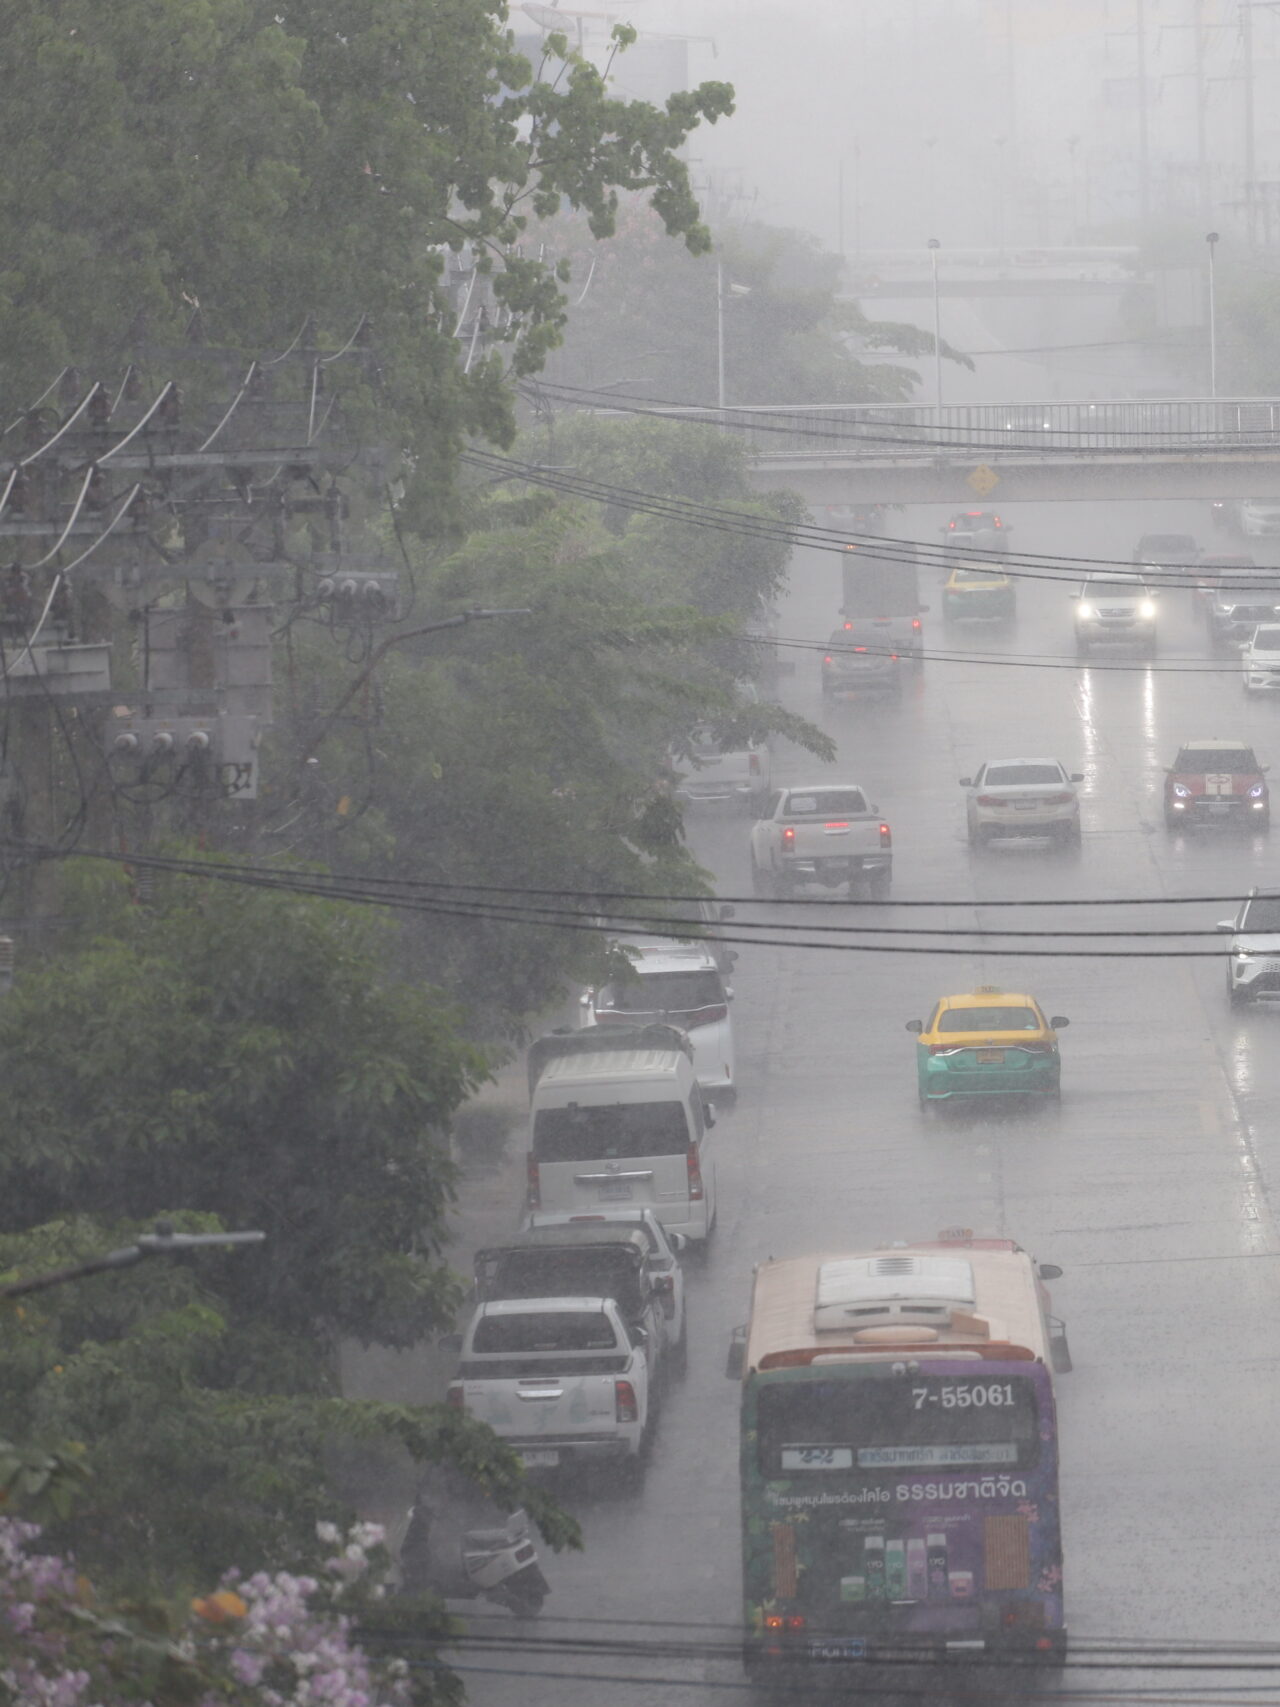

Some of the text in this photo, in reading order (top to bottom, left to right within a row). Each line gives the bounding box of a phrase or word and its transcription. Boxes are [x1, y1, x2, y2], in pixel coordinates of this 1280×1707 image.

[911, 1383, 1015, 1410] 7-55061
[896, 1475, 1027, 1501] ธรรมชาติจัด
